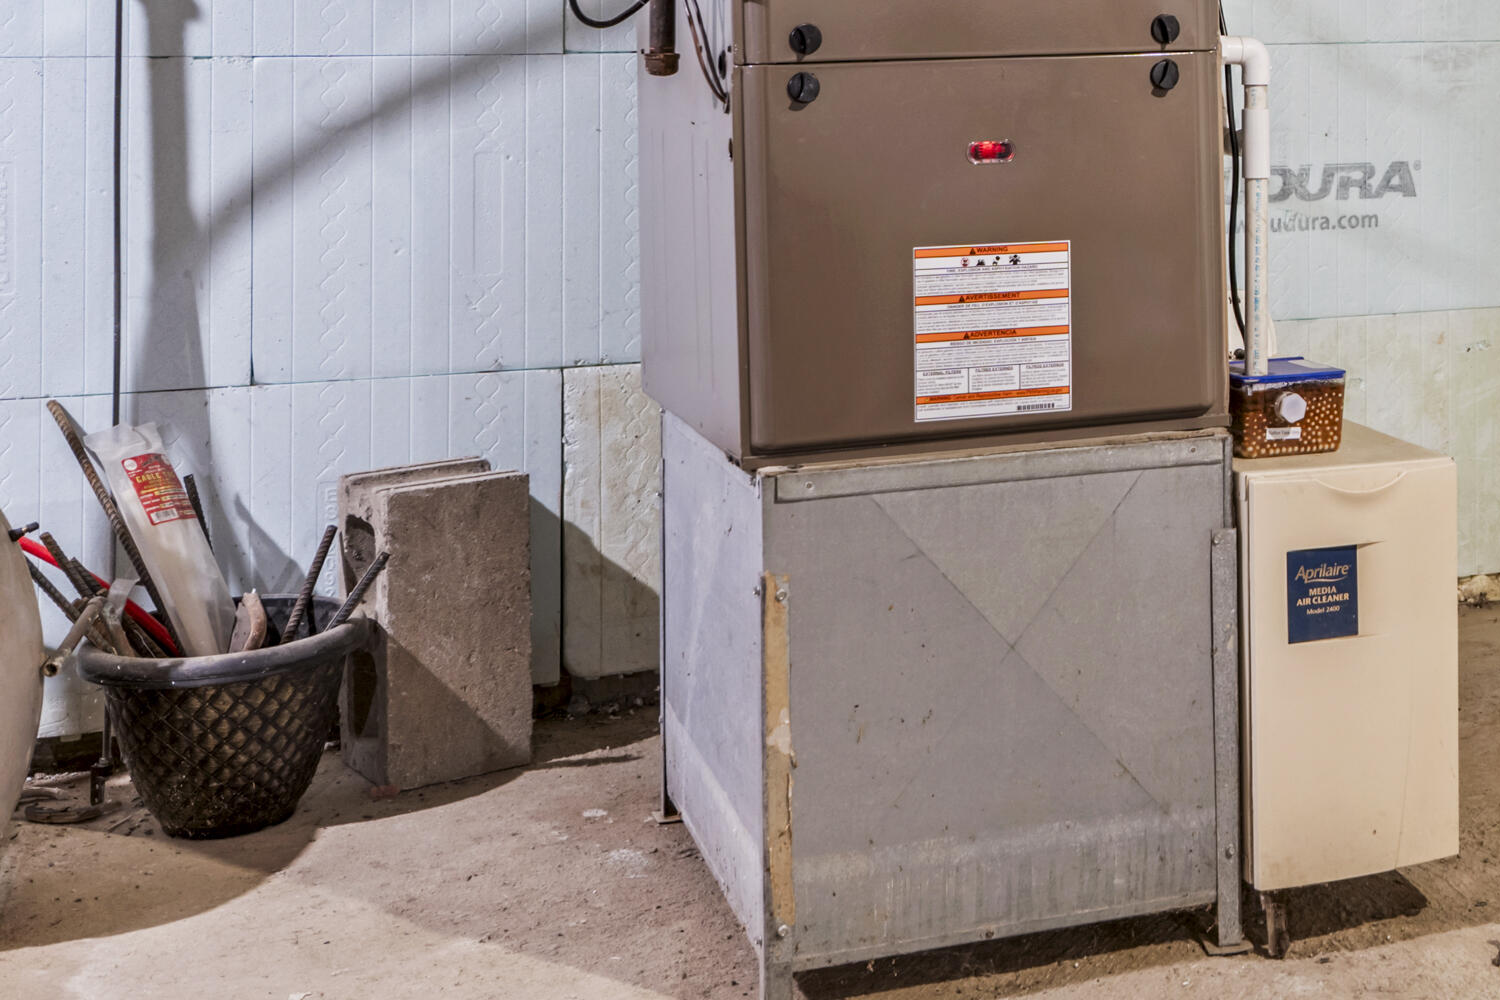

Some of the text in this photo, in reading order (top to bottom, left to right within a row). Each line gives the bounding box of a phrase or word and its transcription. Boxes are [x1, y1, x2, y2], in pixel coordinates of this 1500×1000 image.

[965, 292, 1021, 301] AVERTISSEMENT
[970, 329, 1017, 338] ADVERTENCIA
[1294, 562, 1350, 584] Aprilaire
[1308, 586, 1337, 596] MEDIA
[1296, 592, 1349, 606] AIR CLEANER
[1306, 605, 1340, 615] Model 2400
